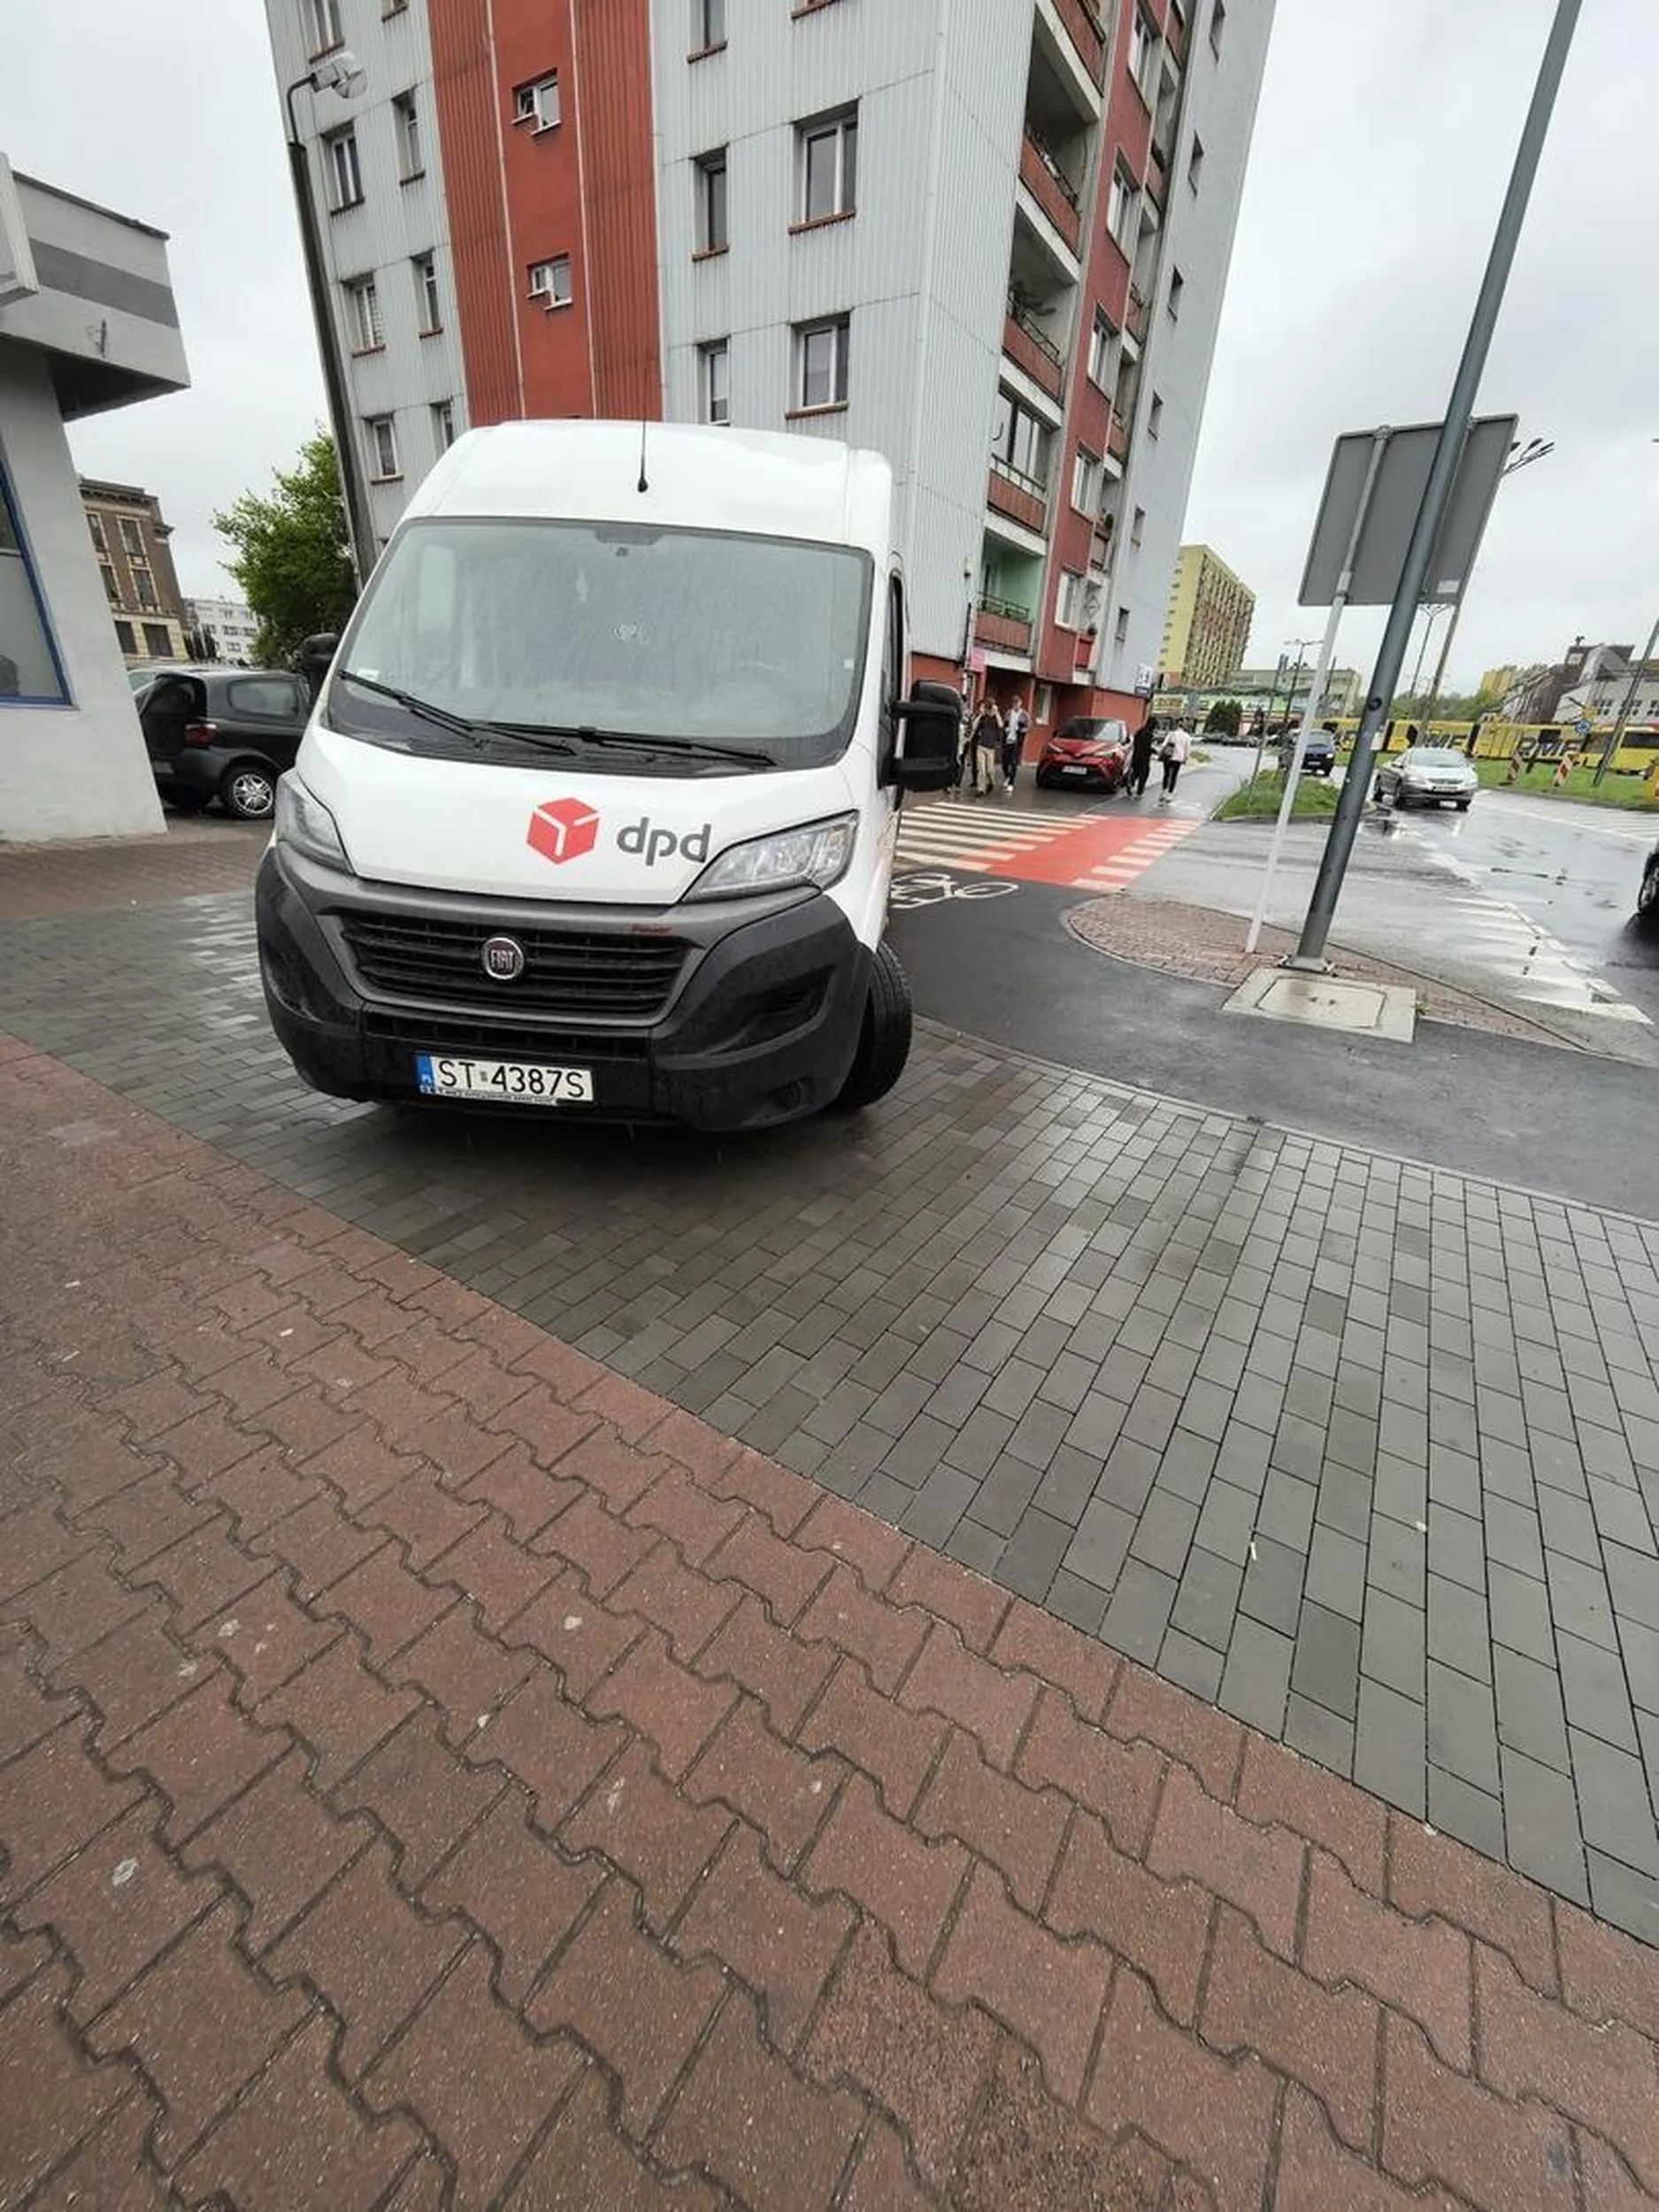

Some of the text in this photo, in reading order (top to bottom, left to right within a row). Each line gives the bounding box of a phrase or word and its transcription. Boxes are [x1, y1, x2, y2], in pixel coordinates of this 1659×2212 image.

[617, 817, 711, 866] dpd
[491, 949, 514, 970] FIAT
[439, 1060, 476, 1089] ST
[491, 1065, 585, 1098] 4387S
